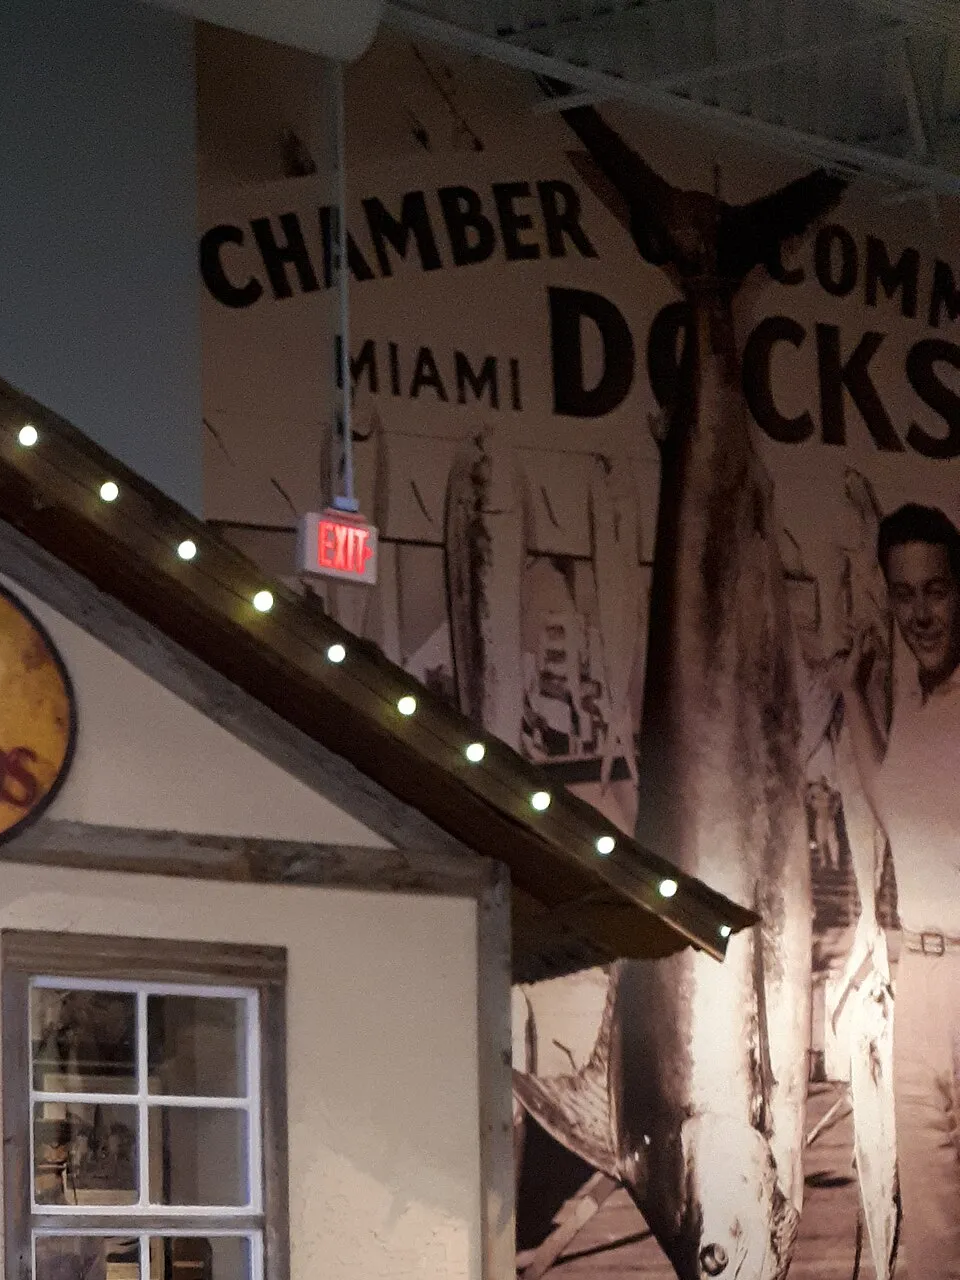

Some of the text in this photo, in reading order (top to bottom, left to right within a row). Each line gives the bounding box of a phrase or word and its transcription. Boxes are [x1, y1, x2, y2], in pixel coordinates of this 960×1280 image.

[199, 179, 599, 309] CHAMBER
[334, 335, 524, 412] MIAMI
[318, 519, 370, 576] EXIT
